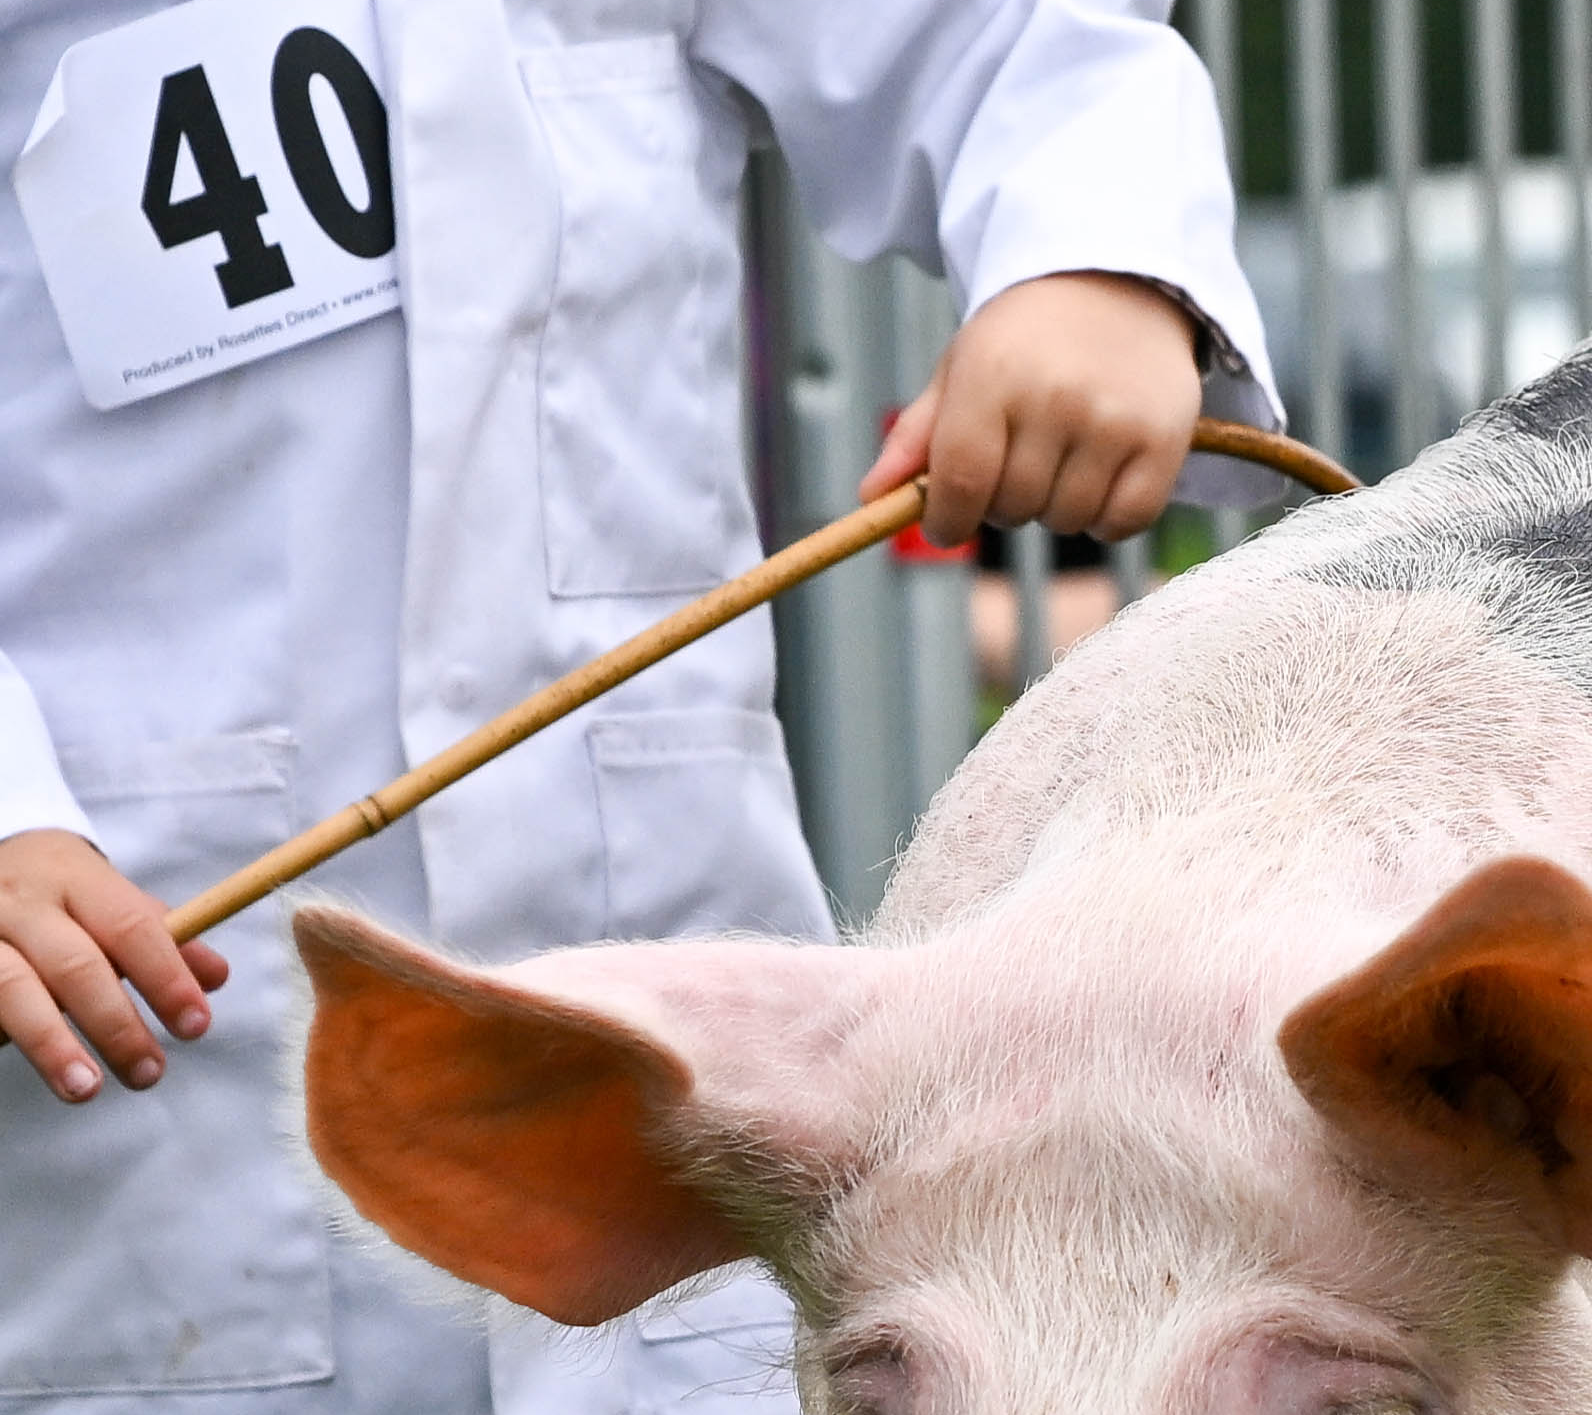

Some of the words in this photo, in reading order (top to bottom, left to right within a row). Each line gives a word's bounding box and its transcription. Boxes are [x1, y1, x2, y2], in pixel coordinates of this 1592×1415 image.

[141, 26, 396, 310] 40
[122, 348, 193, 385] Produced
[196, 344, 215, 361] by
[285, 301, 329, 326] Direct
